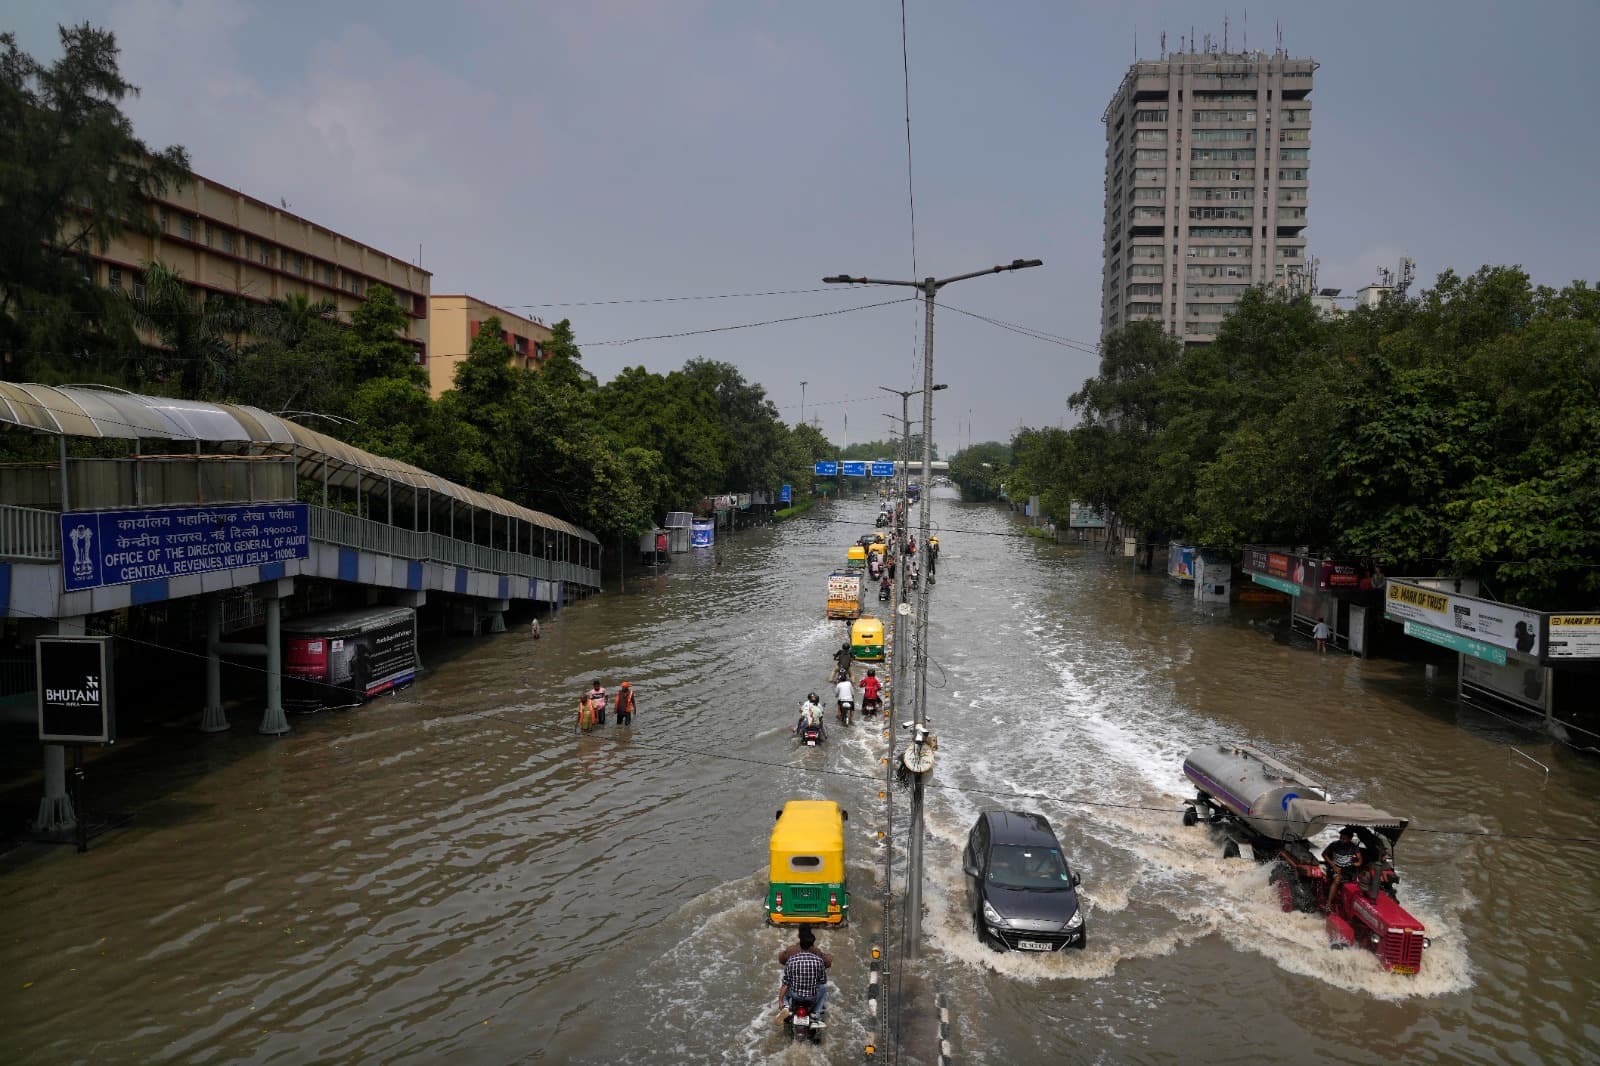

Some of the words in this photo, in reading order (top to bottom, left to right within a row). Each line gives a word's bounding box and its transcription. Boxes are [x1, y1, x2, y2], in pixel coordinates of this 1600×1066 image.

[117, 514, 170, 531] कार्यालय
[242, 510, 265, 521] लेखा
[268, 507, 295, 520] परीक्षा
[116, 532, 160, 549] केन्द्रीय
[166, 532, 207, 544] राजस्व,
[209, 527, 225, 541] नई
[104, 551, 143, 567] OFFICE
[147, 549, 161, 562] OF
[165, 546, 185, 560] THE
[187, 542, 231, 557] DIRECTOR
[234, 538, 272, 552] GENERAL
[274, 537, 284, 548] OF
[285, 535, 306, 546] AUDIT
[120, 562, 170, 580] CENTRAL
[174, 557, 224, 573] REVENUES,
[225, 553, 243, 566] NEW
[246, 551, 268, 564] DELHI
[1401, 586, 1418, 604] MARK
[1417, 592, 1426, 606] OF
[1427, 595, 1447, 612] TRUST
[1563, 617, 1584, 625] MARK
[46, 688, 99, 702] BHUTANI
